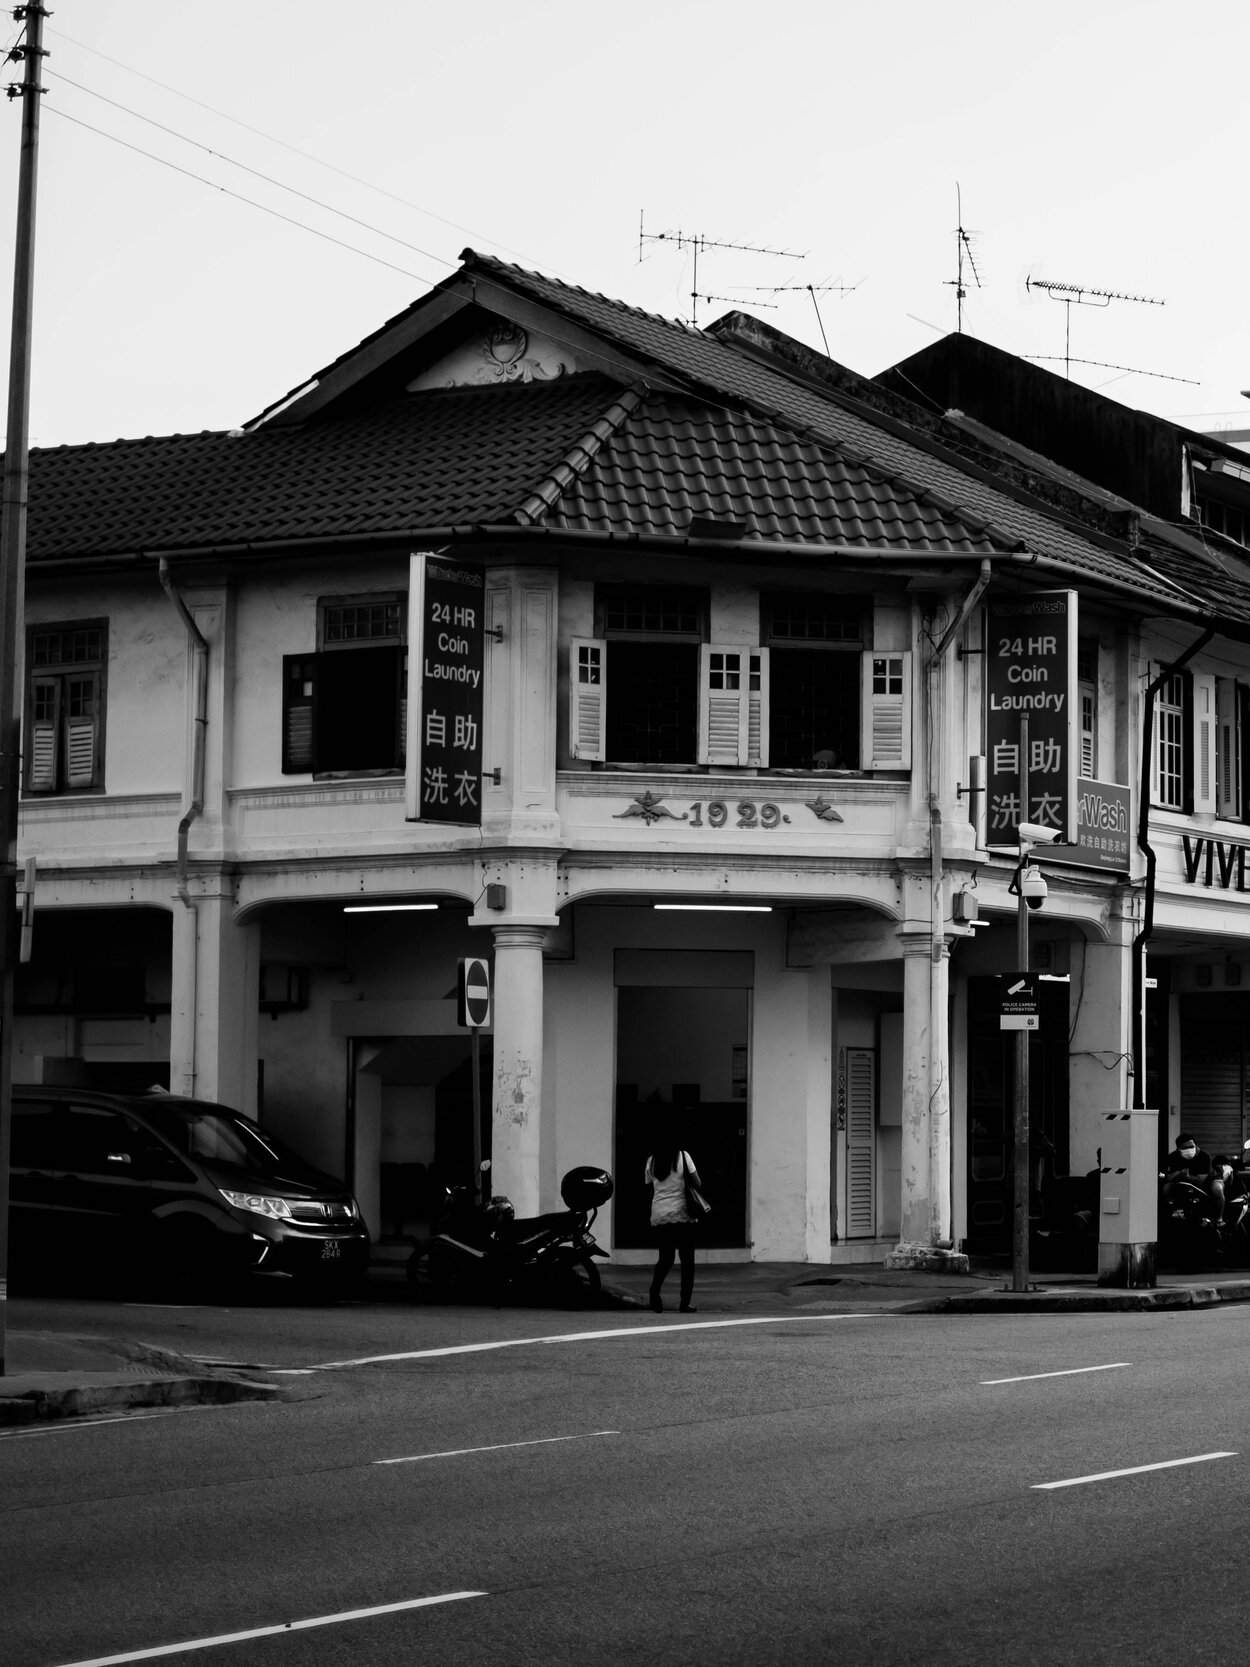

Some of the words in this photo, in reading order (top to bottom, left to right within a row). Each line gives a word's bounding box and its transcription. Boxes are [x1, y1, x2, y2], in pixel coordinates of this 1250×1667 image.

[432, 602, 450, 624] 24
[454, 606, 475, 628] HR
[438, 633, 468, 655] Coin
[998, 638, 1023, 657] 24
[1028, 636, 1057, 655] HR
[424, 658, 480, 688] Laundry
[1007, 665, 1048, 683] Coin
[991, 692, 1064, 712] Laundry
[426, 709, 477, 751] 自助
[993, 738, 1061, 775] 自助
[424, 766, 478, 807] 洗衣
[689, 801, 781, 829] 1929
[991, 792, 1063, 830] 洗衣
